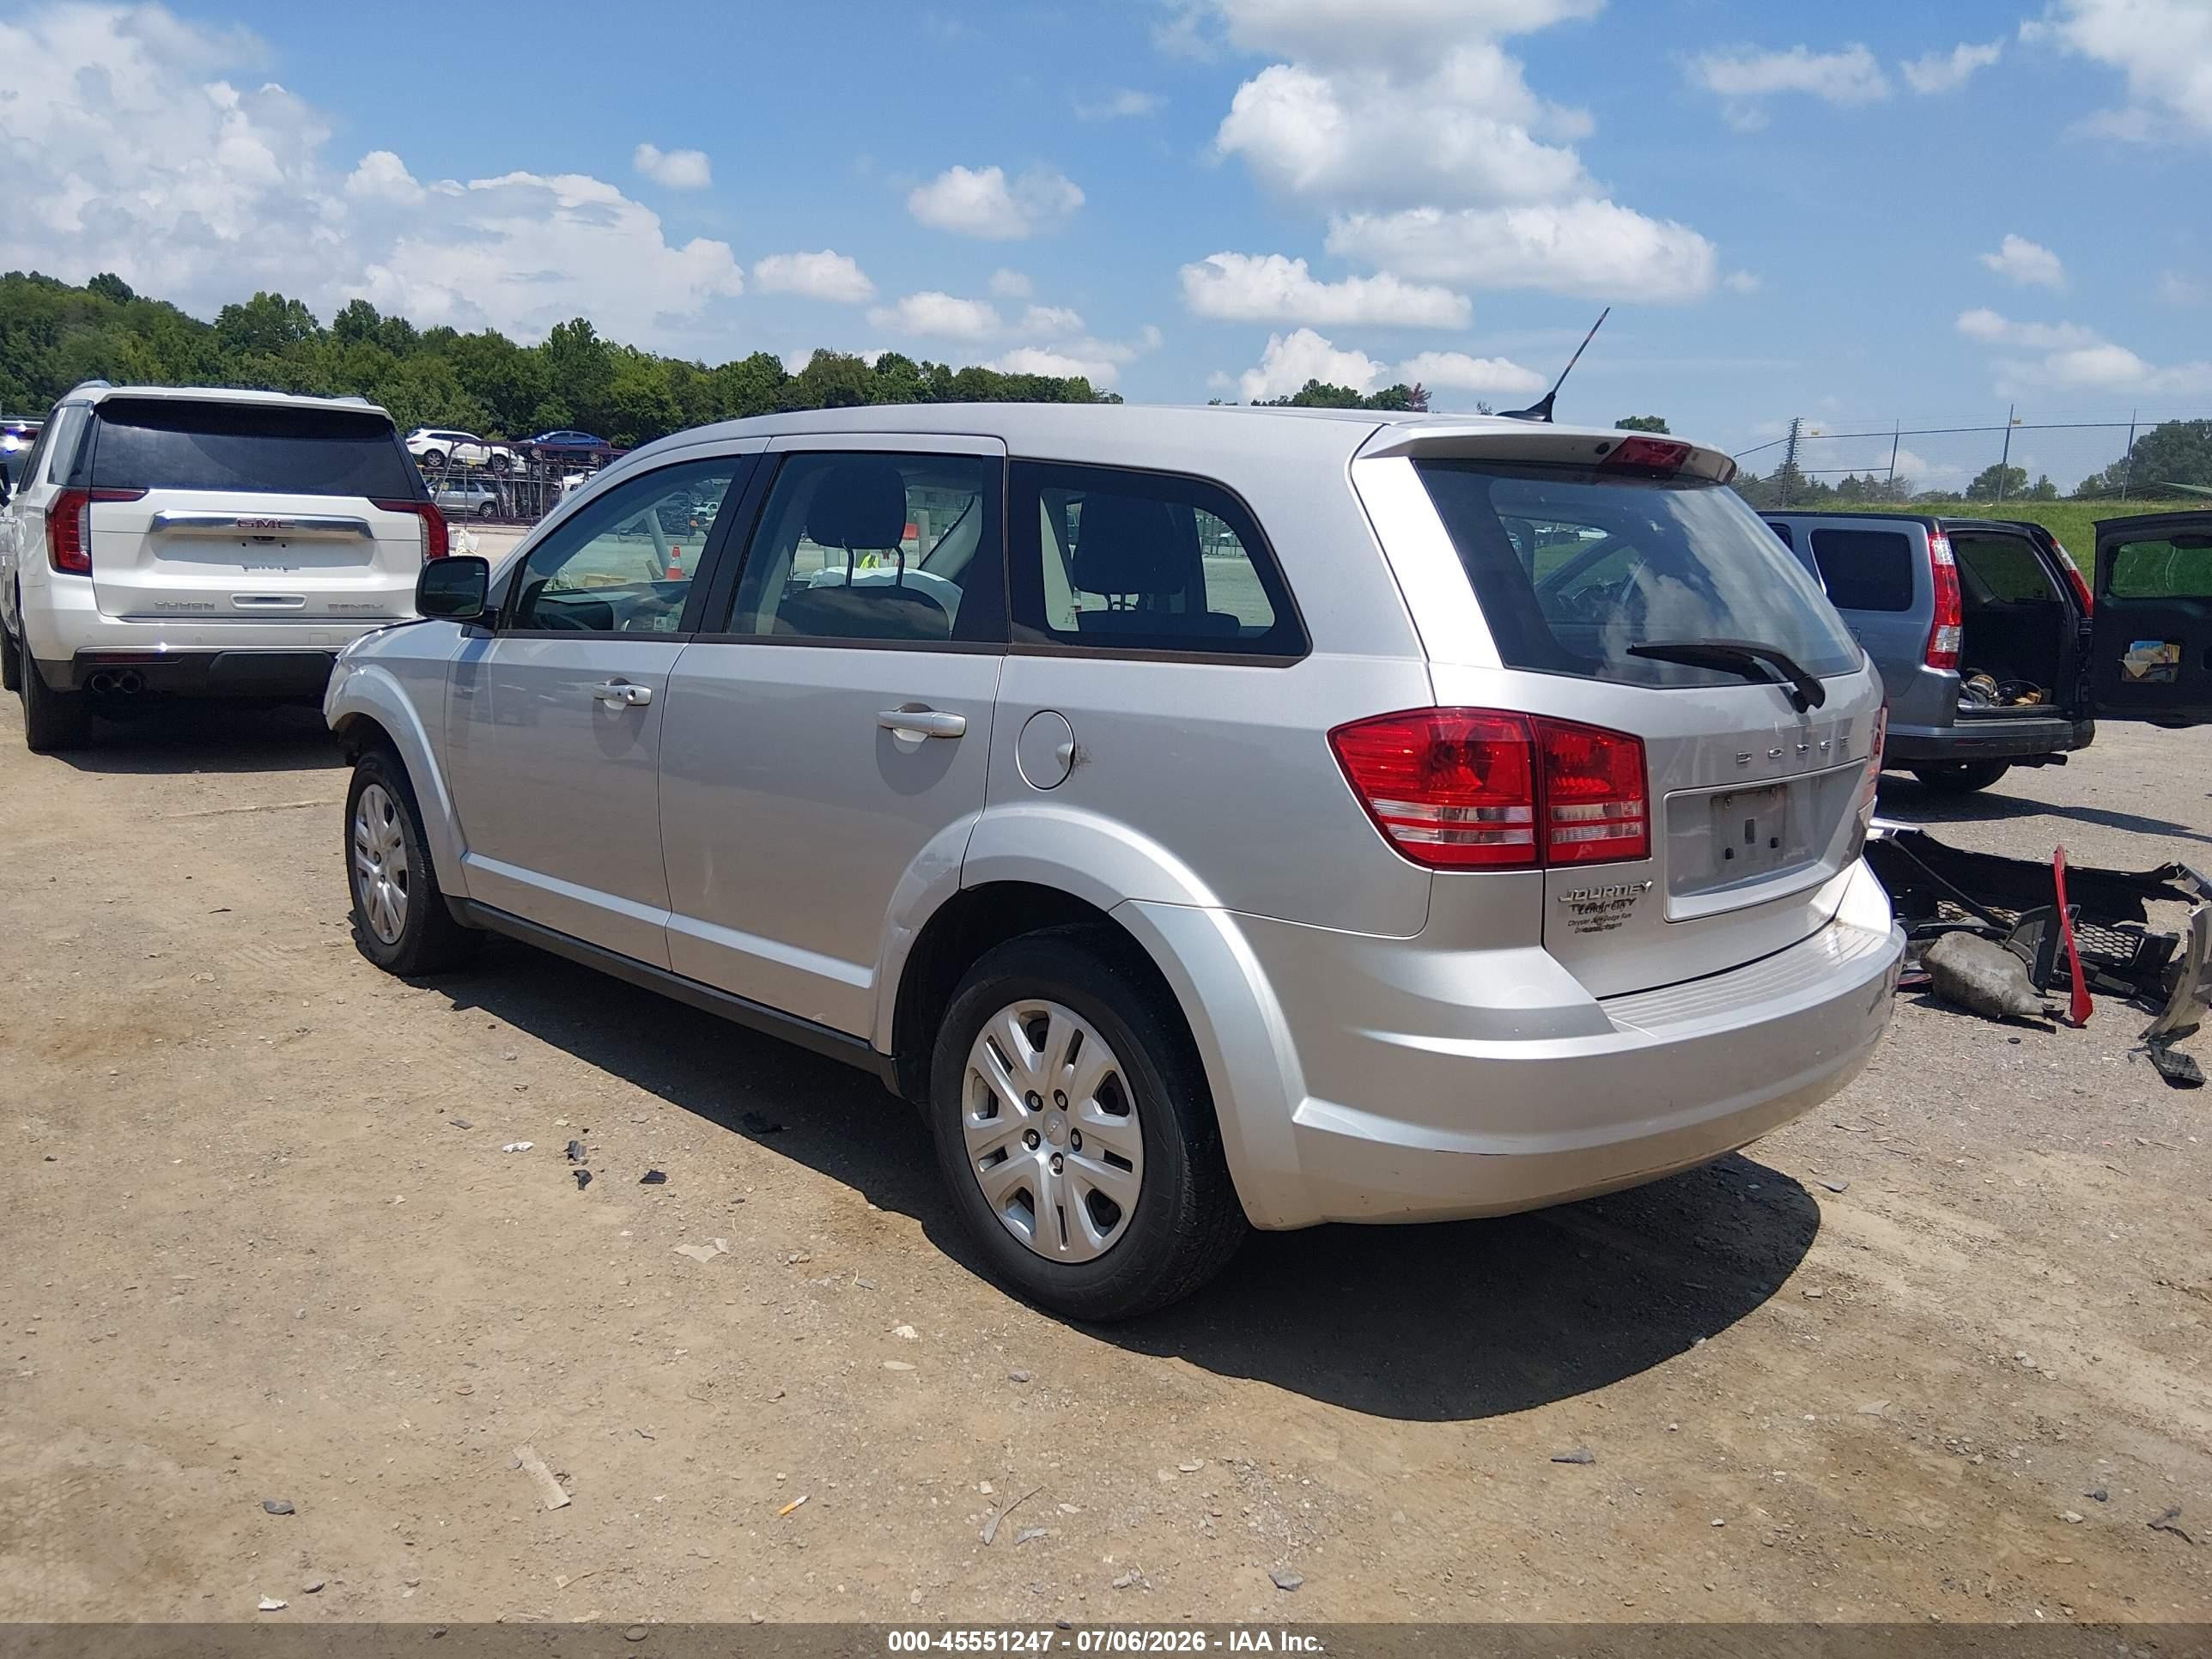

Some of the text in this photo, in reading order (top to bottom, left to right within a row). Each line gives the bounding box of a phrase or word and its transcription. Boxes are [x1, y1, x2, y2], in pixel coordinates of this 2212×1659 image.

[236, 517, 295, 529] GMC
[1736, 736, 1850, 764] DODGE
[1558, 880, 1653, 902] JOURNEY
